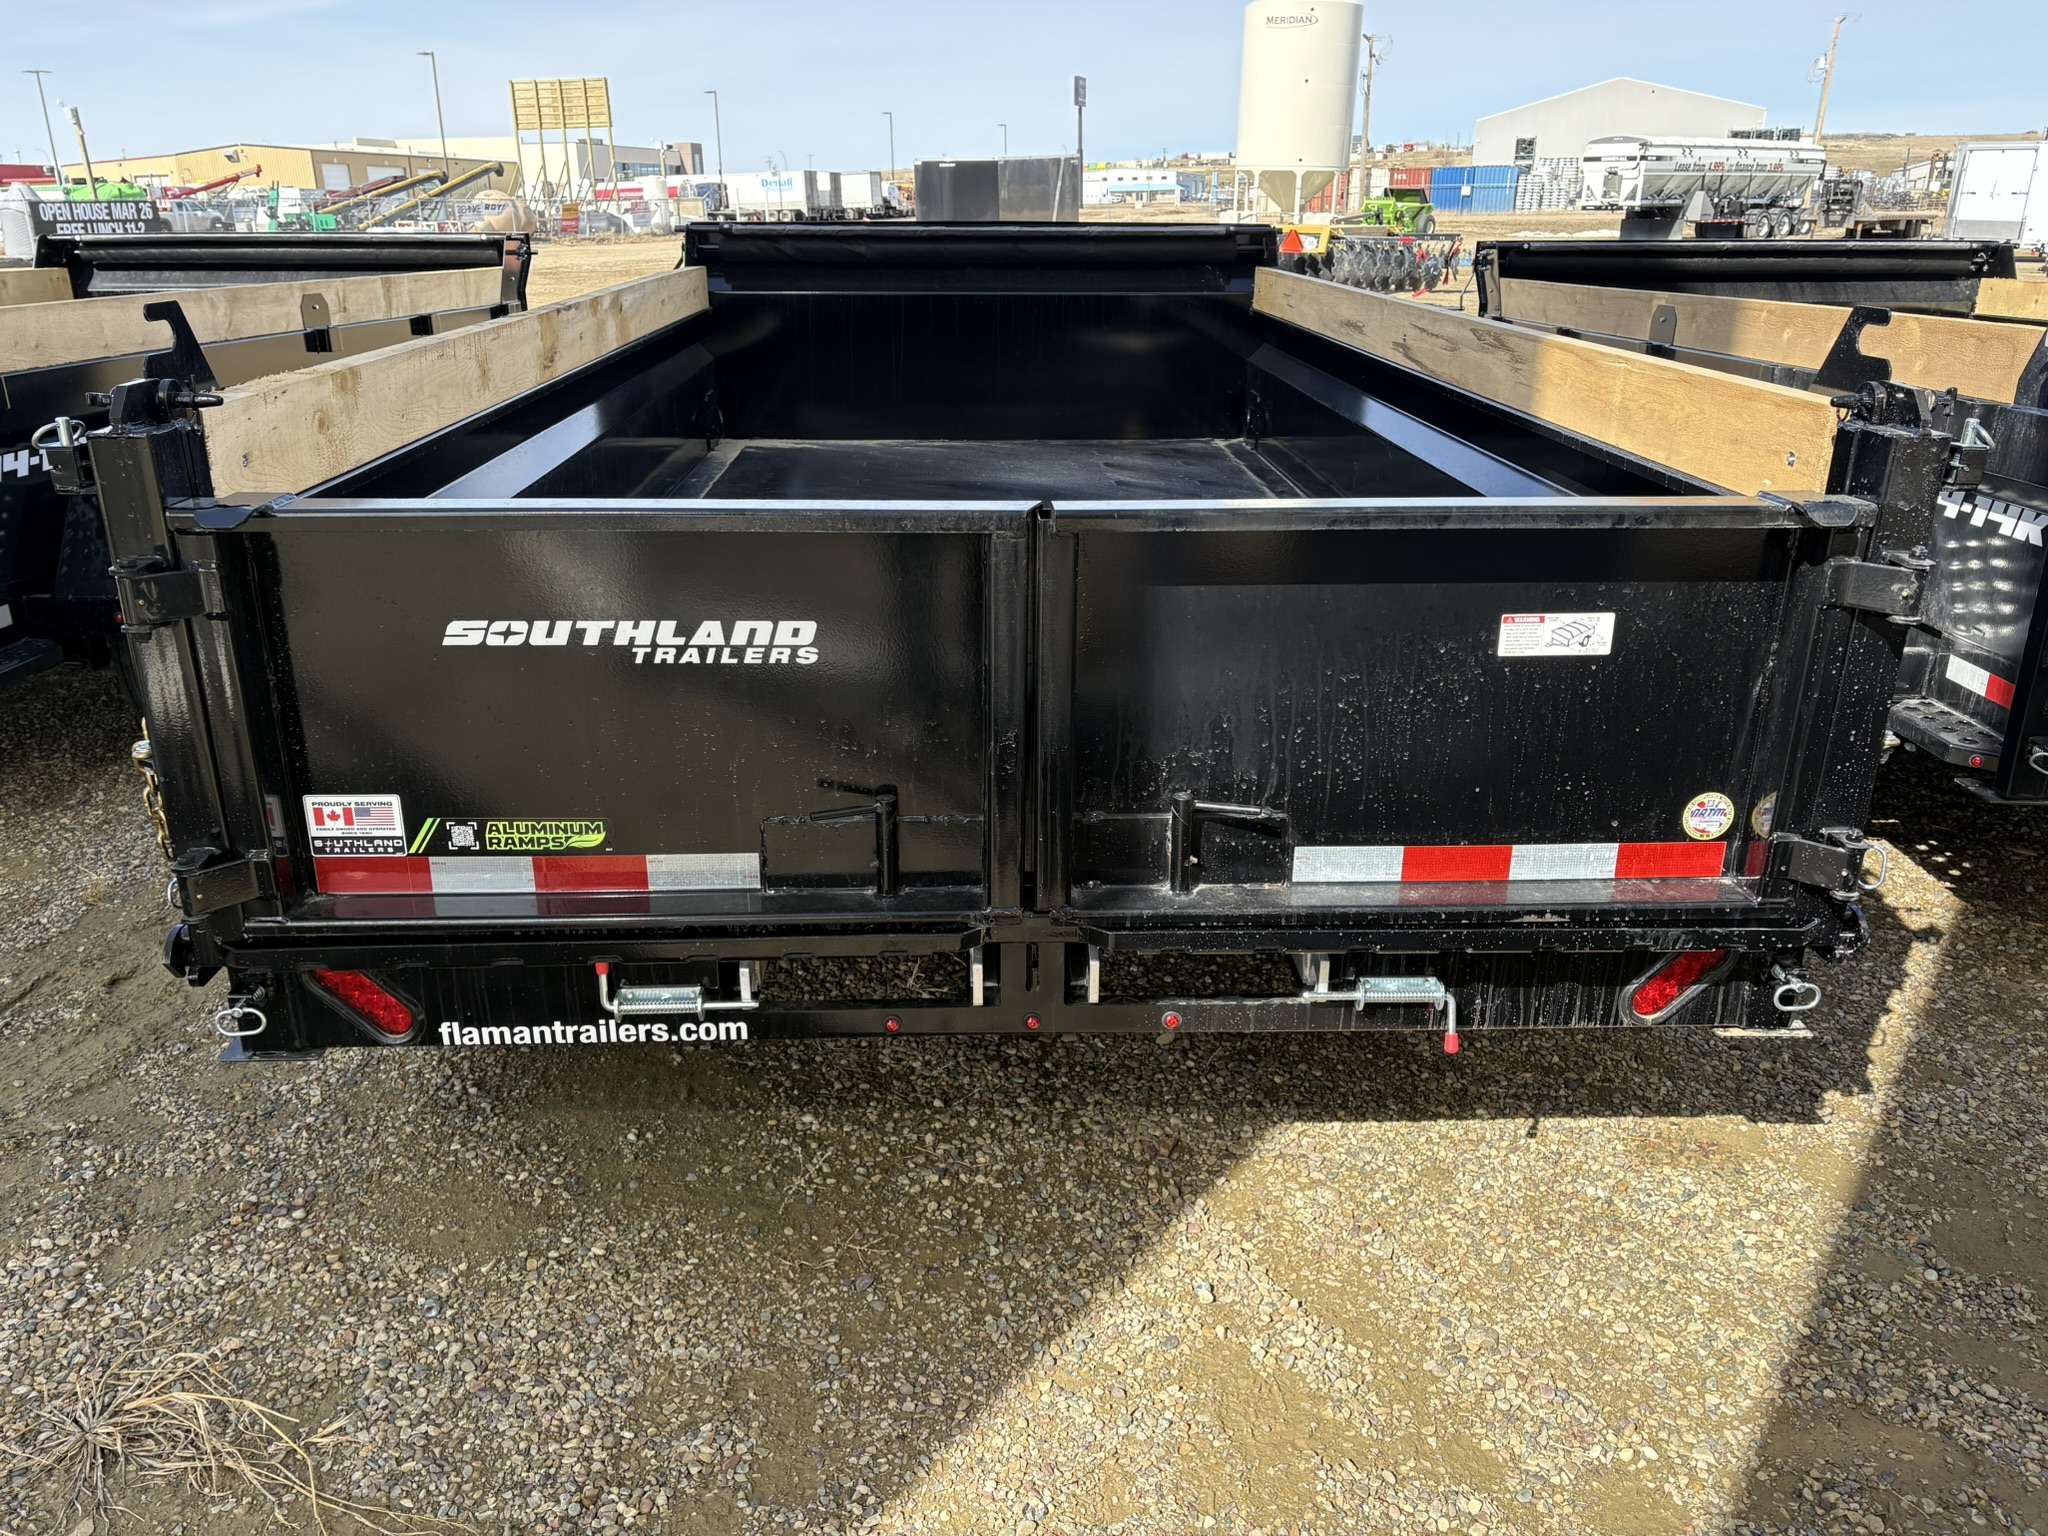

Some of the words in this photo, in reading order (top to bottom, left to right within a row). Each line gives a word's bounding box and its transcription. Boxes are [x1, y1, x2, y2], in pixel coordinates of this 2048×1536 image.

[1266, 15, 1313, 25] MERIDIAN
[40, 203, 71, 220] OPEN
[72, 203, 110, 220] HOUSE
[111, 203, 136, 220] MAR
[139, 202, 153, 219] 26
[442, 620, 818, 646] SOUTHLAND
[632, 647, 820, 664] TRAILERS
[486, 821, 604, 835] ALUMINUM
[486, 835, 566, 850] RAMPS
[438, 1019, 748, 1046] flamantrailers.com
